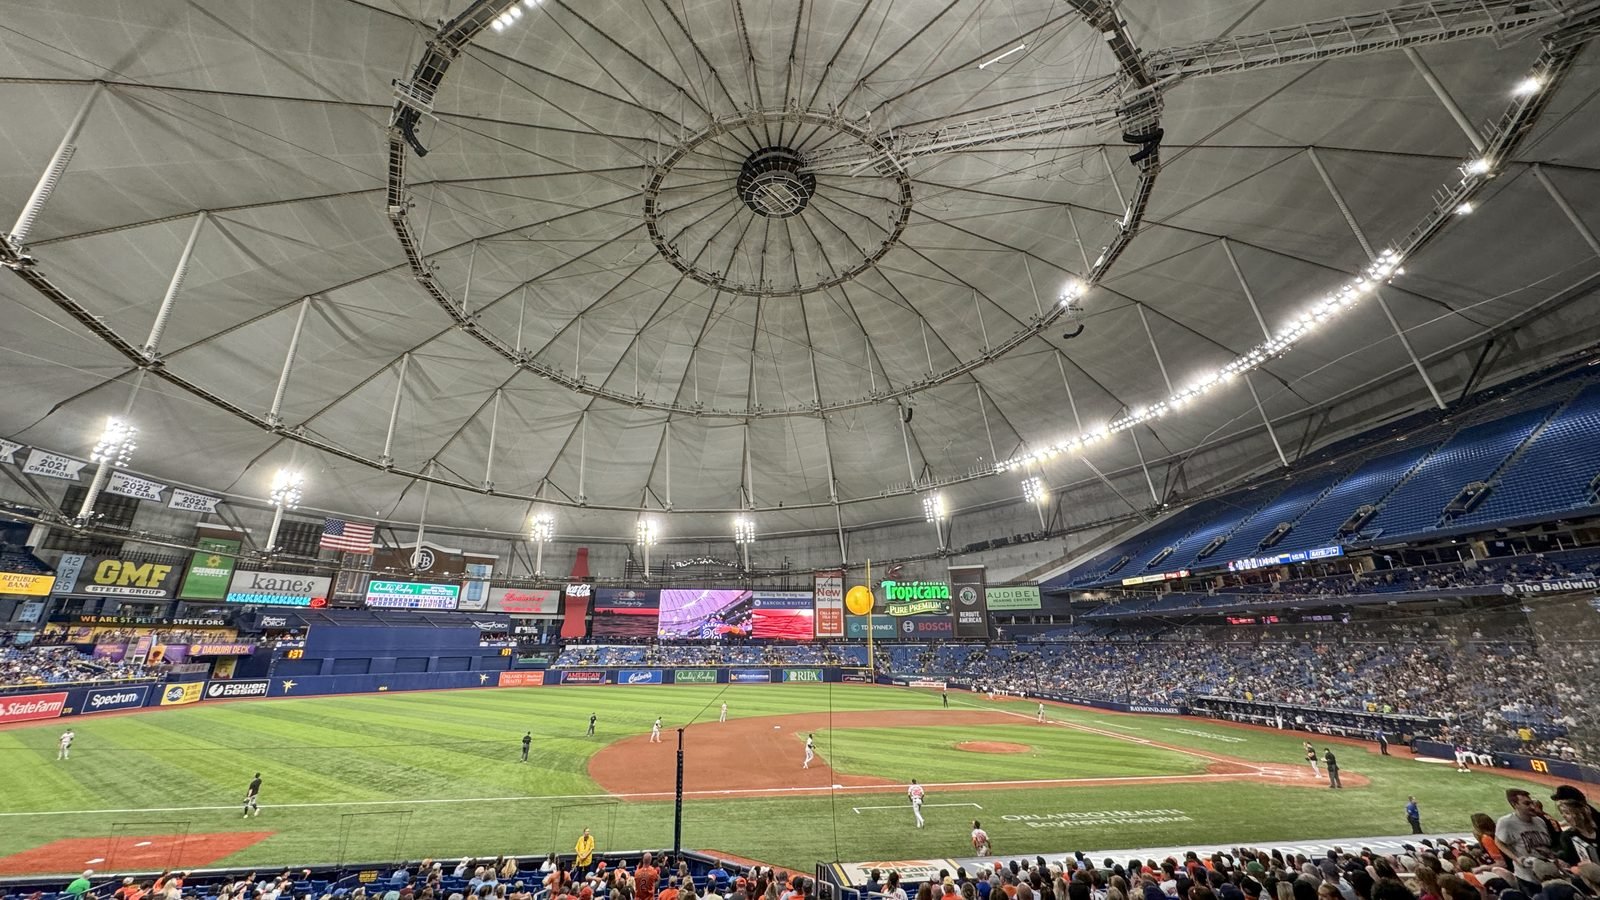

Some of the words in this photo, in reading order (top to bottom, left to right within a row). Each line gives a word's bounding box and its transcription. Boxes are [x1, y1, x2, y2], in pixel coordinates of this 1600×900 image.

[40, 459, 68, 471] 2021
[28, 465, 74, 479] CHAMPIONS
[112, 485, 132, 494] WILD
[134, 490, 156, 499] CARD
[122, 480, 151, 493] 2022
[174, 501, 192, 509] WILD
[183, 496, 208, 507] 2023
[65, 557, 80, 566] 42
[2, 574, 41, 584] REPUBLIC
[61, 569, 75, 578] 12
[94, 559, 172, 588] GMF
[55, 581, 71, 590] 66
[881, 580, 950, 602] Tropicana
[1516, 583, 1540, 592] The
[1542, 579, 1597, 590] Baldwin
[816, 588, 841, 597] New
[987, 590, 1039, 599] AUDIBEL
[890, 605, 909, 614] PURE
[909, 601, 942, 612] PREMIUM
[173, 618, 225, 626] STPETE.ORG
[918, 622, 952, 631] BOSCH
[202, 645, 232, 654] DAIQUIRI
[232, 645, 249, 654] DECK
[676, 671, 697, 682] Quality
[696, 671, 715, 681] Roofing
[91, 692, 138, 708] Spectrum
[1530, 759, 1549, 773] 137
[1001, 811, 1105, 821] ORLANDO
[1101, 808, 1186, 817] HEALTH
[1025, 819, 1114, 828] Bayfront
[1112, 815, 1194, 825] Hospital
